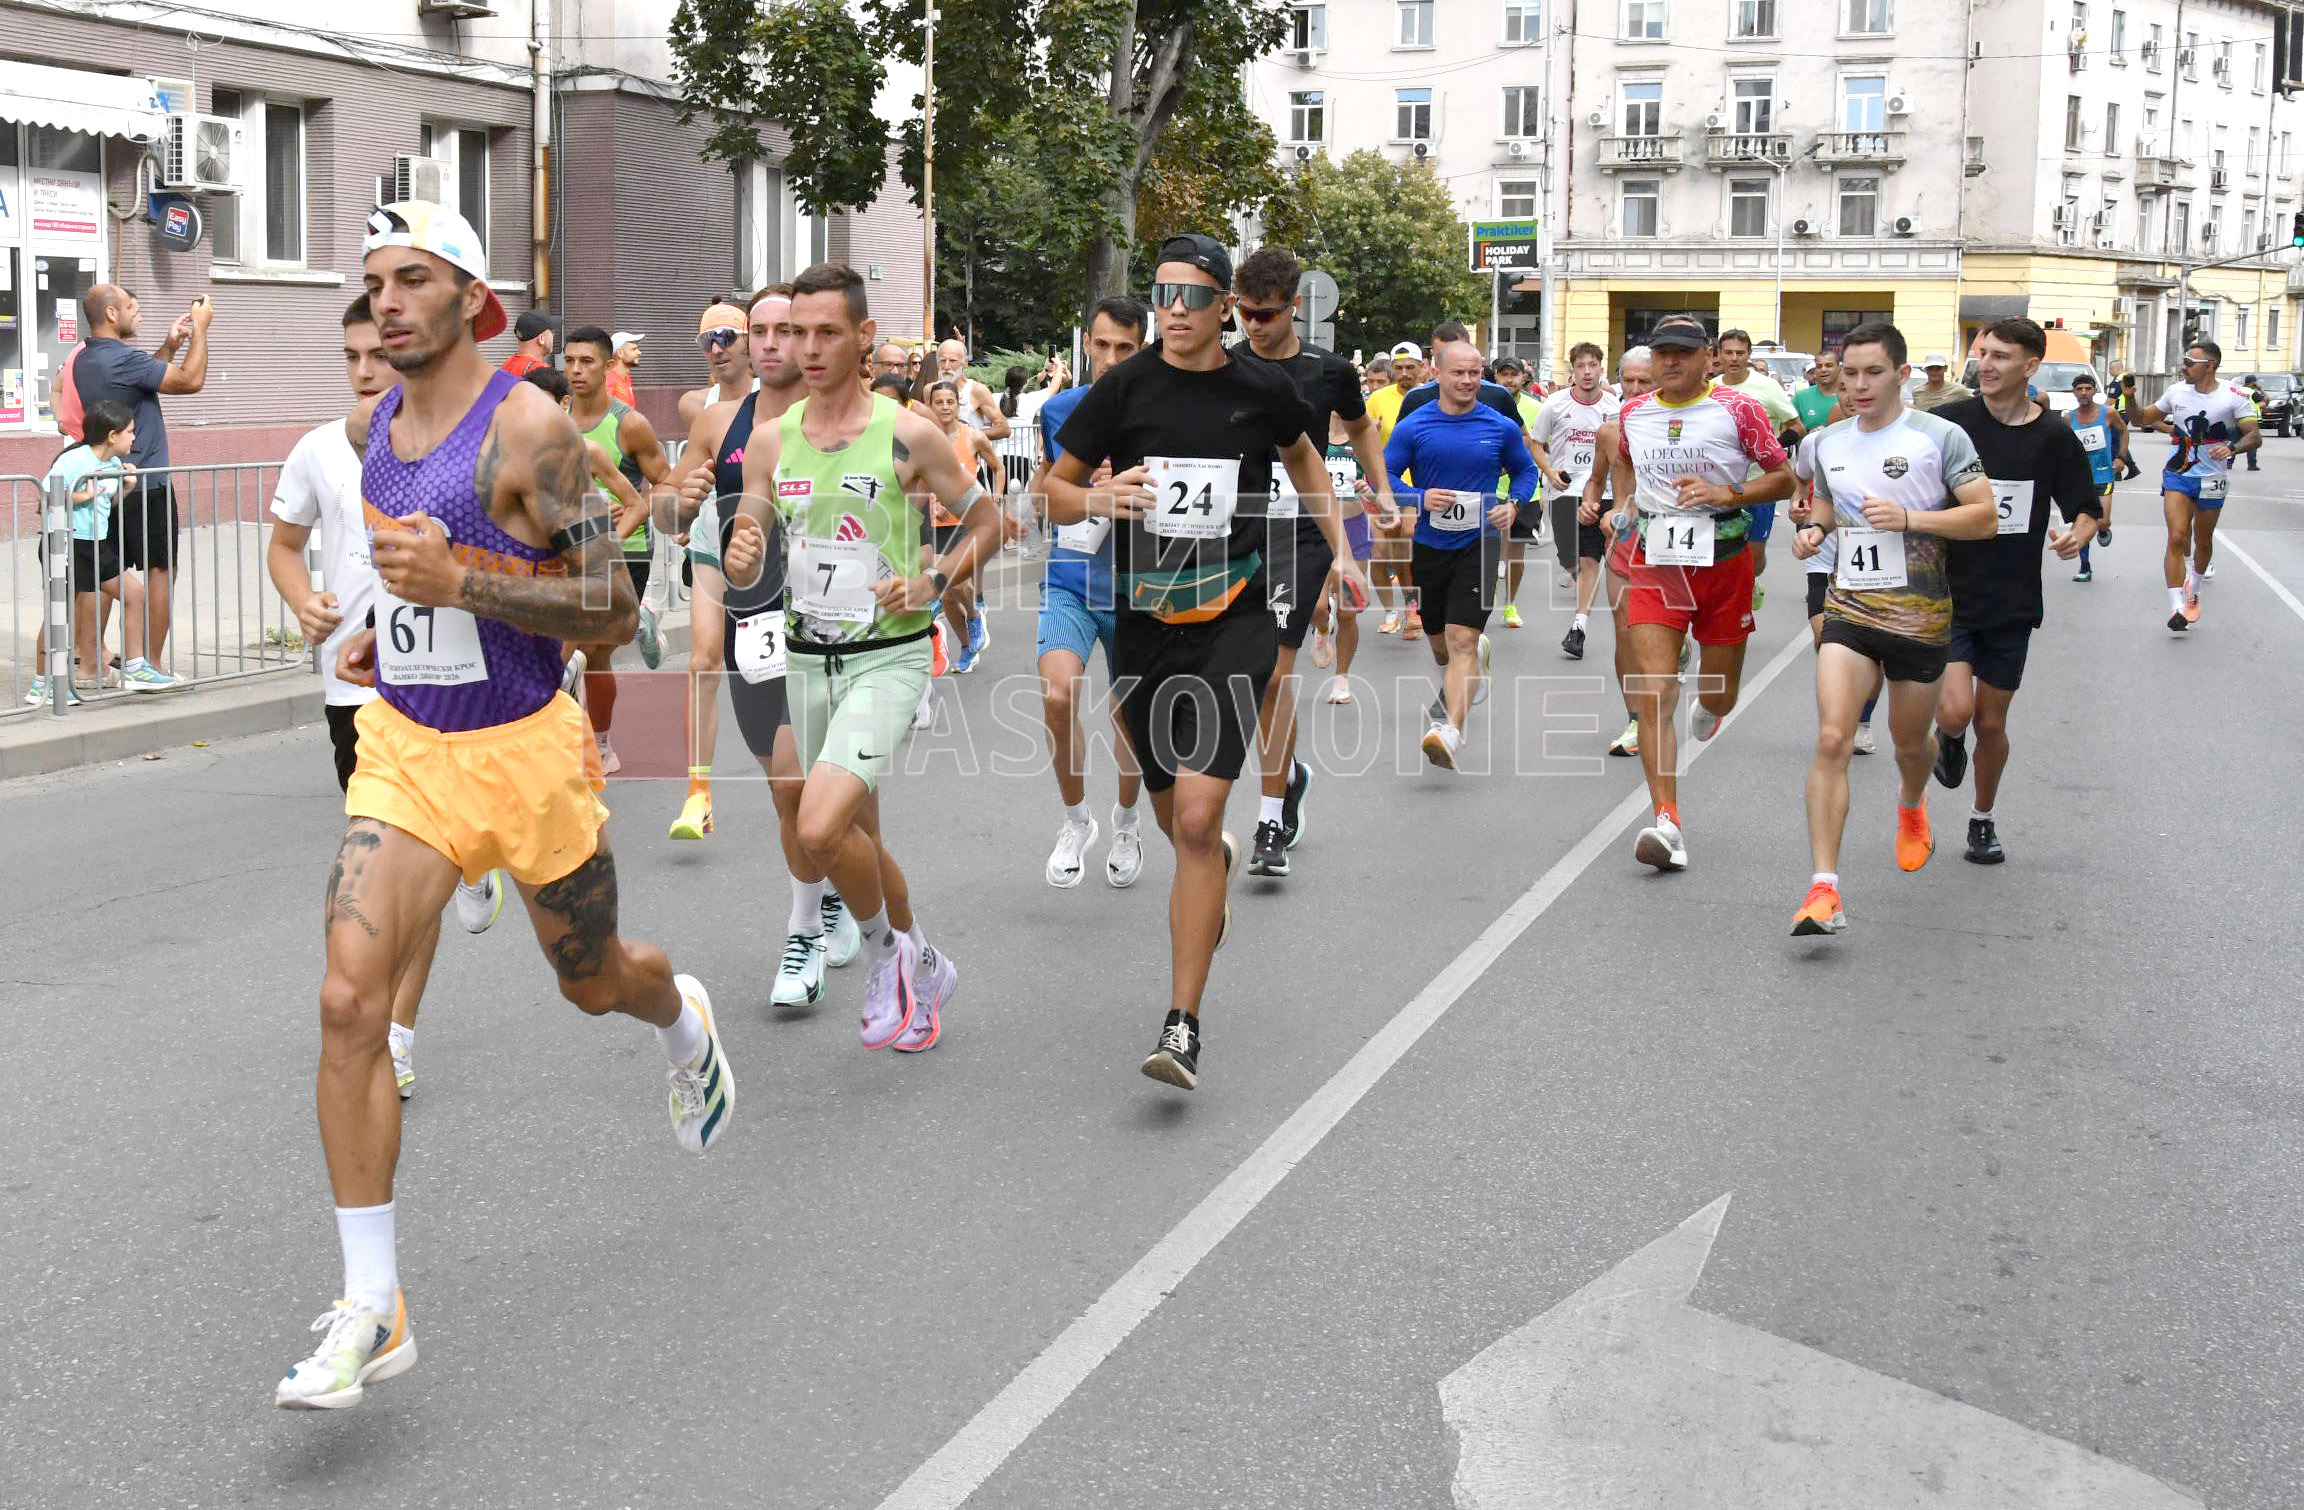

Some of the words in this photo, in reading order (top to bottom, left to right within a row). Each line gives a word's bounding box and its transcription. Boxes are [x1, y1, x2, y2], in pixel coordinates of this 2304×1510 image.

[170, 212, 186, 225] Easy
[168, 220, 181, 232] Pay
[1476, 225, 1534, 237] Praktiker
[1485, 246, 1529, 255] HOLIDAY
[1485, 256, 1512, 265] PARK
[2083, 434, 2097, 445] 62
[1574, 452, 1591, 464] 66
[1652, 448, 1708, 459] DECADE
[780, 483, 809, 492] SLS
[2210, 480, 2227, 491] 30
[1168, 481, 1212, 516] 24
[1441, 503, 1465, 520] 20
[1665, 526, 1695, 550] 14
[1851, 544, 1884, 571] 41
[817, 563, 837, 597] 7
[390, 605, 434, 654] 67
[454, 661, 478, 672] КРОС
